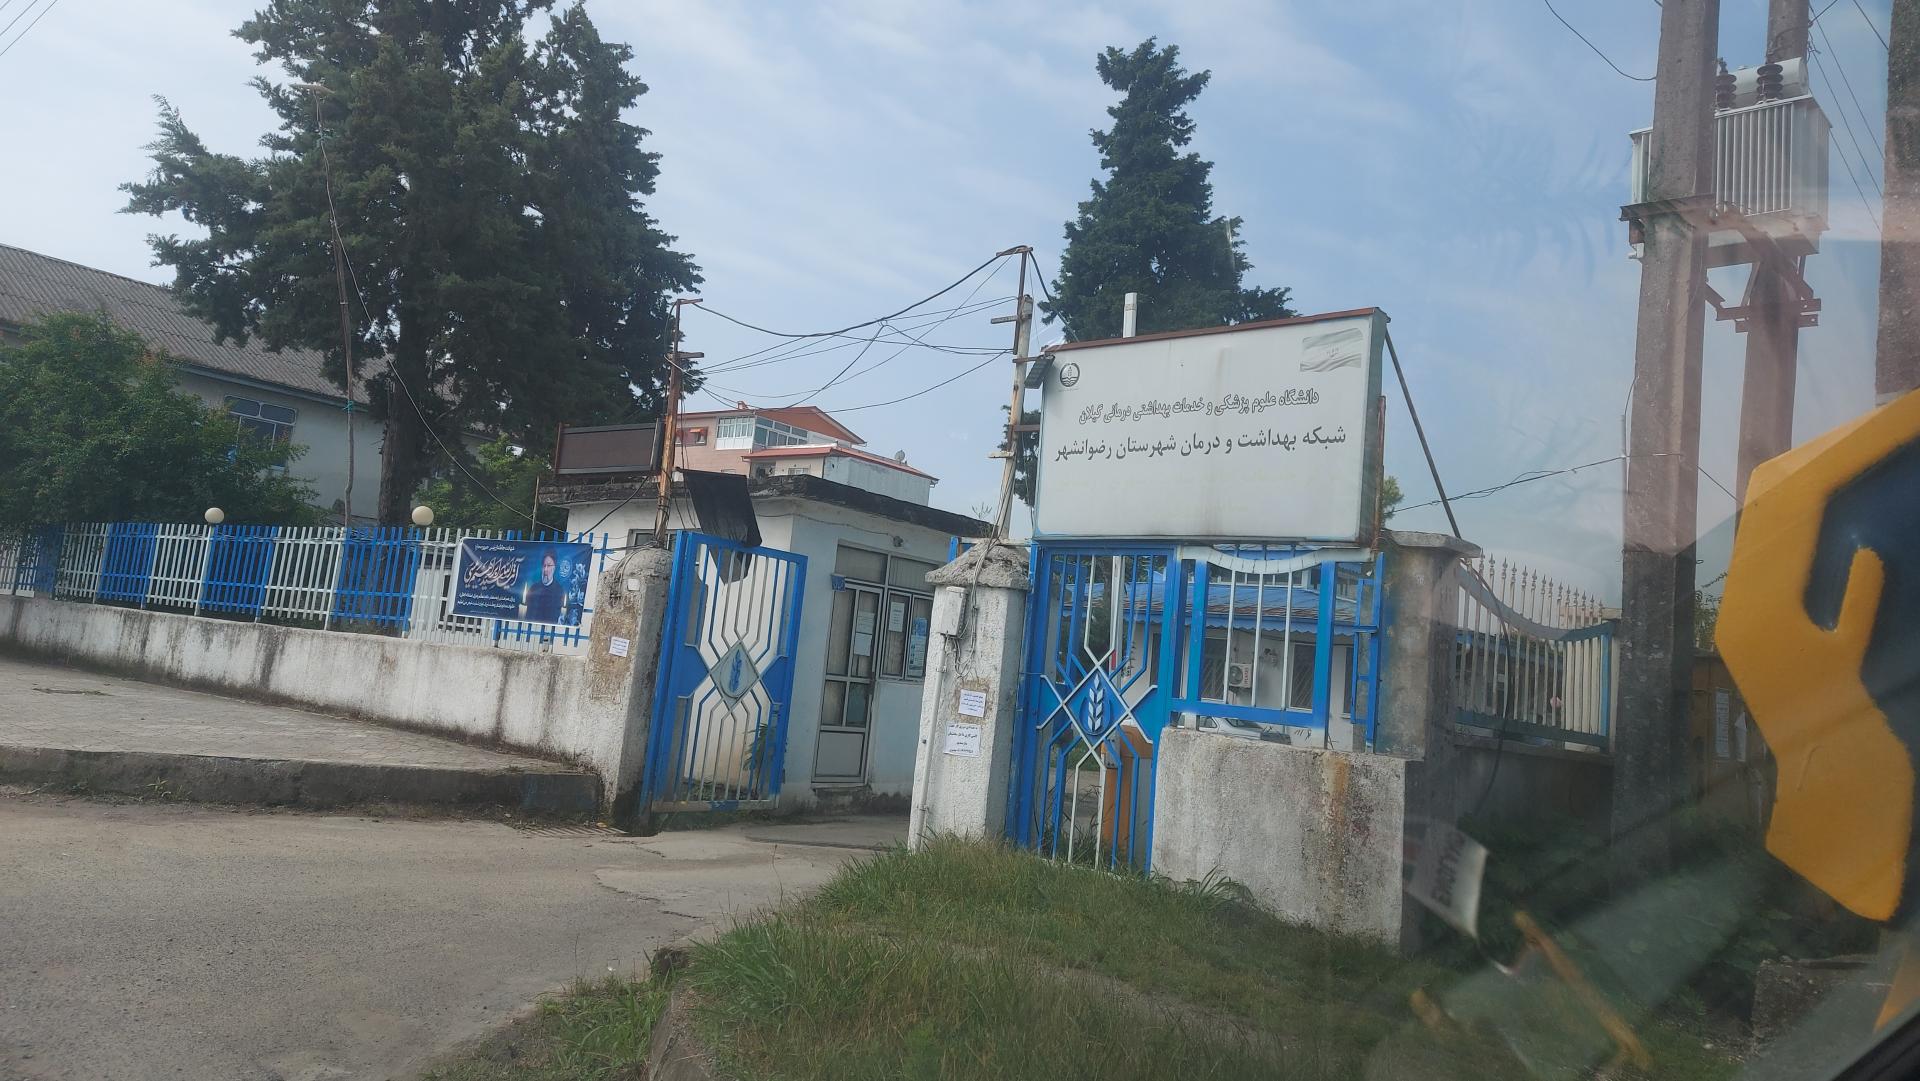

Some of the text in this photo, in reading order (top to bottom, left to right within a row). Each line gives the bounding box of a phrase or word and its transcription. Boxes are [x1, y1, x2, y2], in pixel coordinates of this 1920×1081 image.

[1079, 388, 1320, 424] دانشگاه علوم پزشکی و خدمات بهداشتی درمانی گیلان
[1056, 426, 1346, 461] شبکه بهداشت و درمان شهرستان رضوانشهر
